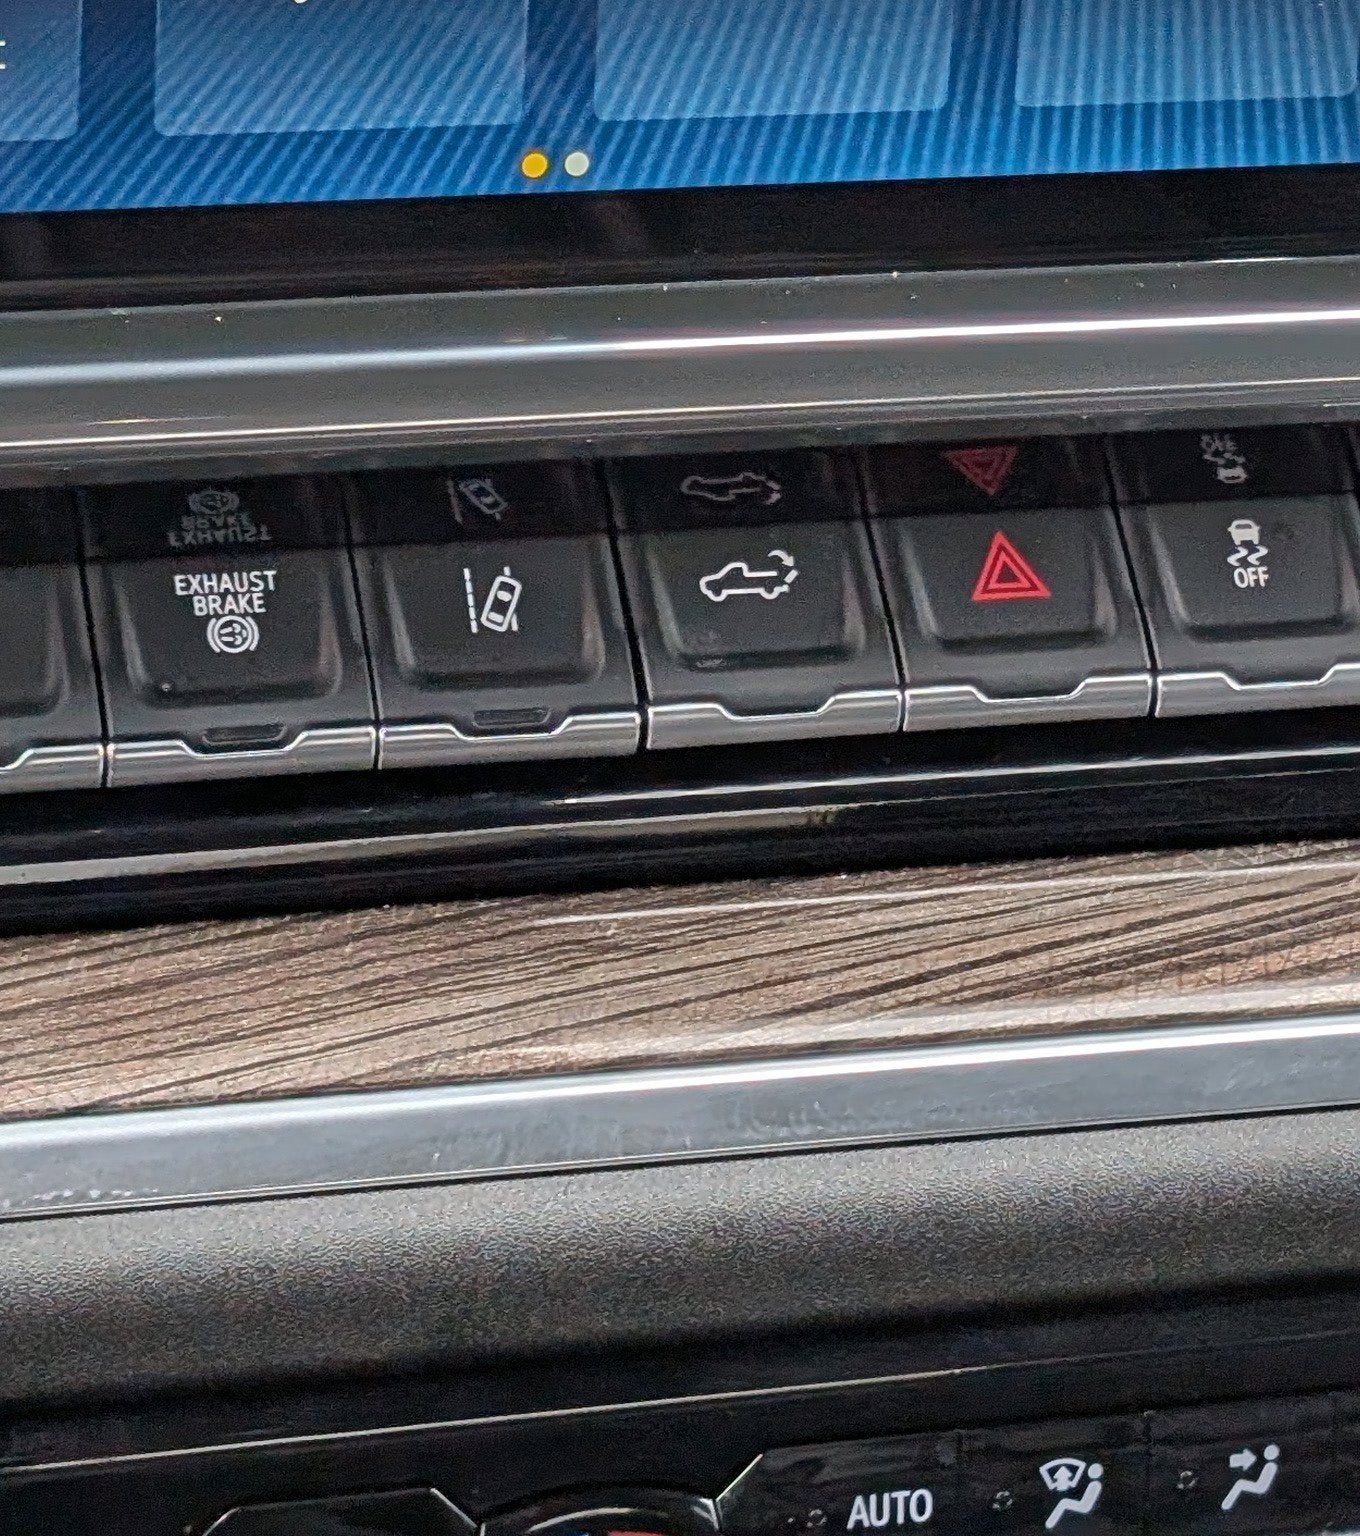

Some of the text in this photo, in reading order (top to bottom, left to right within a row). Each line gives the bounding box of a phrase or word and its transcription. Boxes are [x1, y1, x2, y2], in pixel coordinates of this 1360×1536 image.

[174, 570, 277, 596] EXHAUST
[1233, 566, 1270, 589] OFF
[193, 592, 266, 617] BRAKE
[846, 1488, 933, 1530] AUTO
